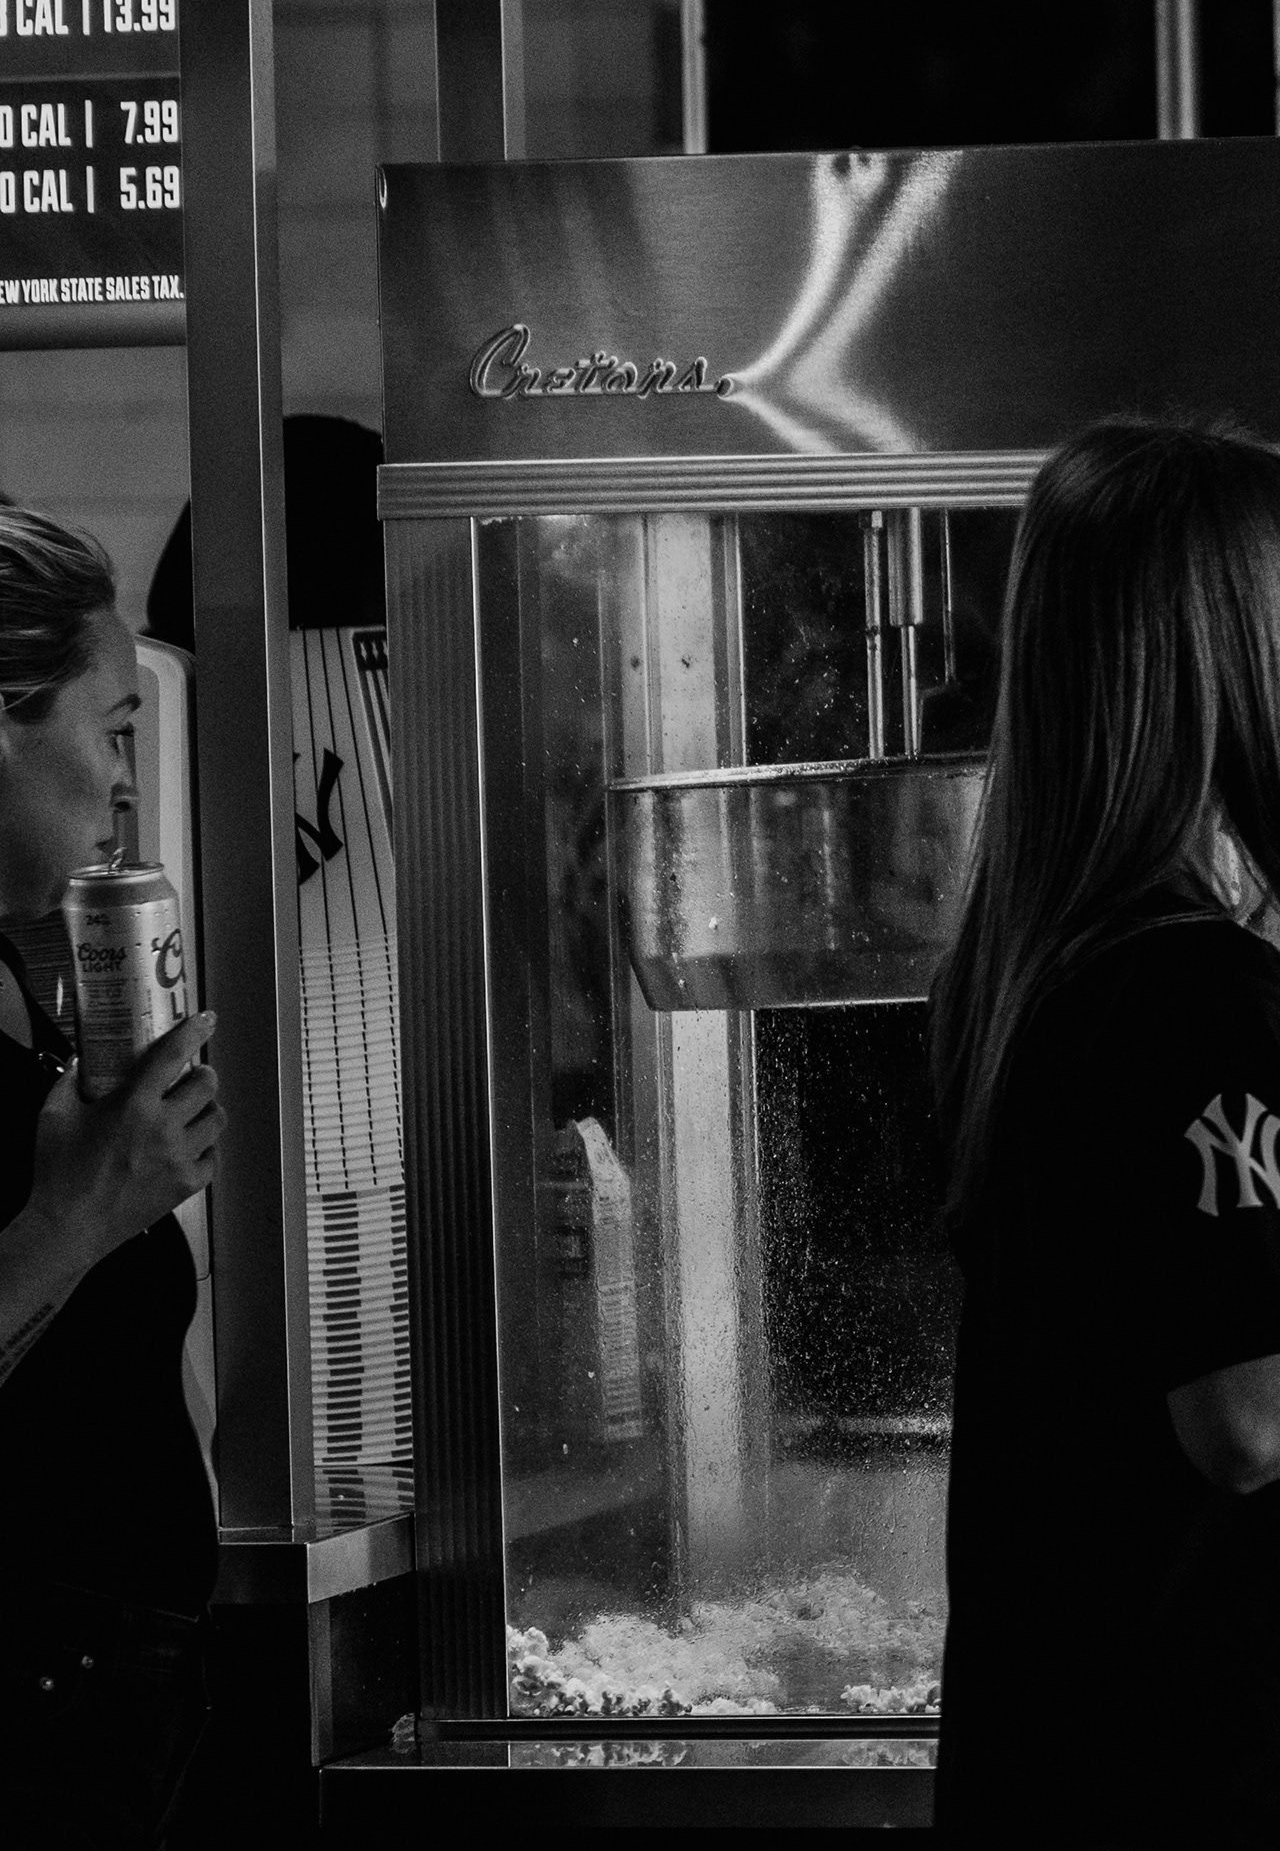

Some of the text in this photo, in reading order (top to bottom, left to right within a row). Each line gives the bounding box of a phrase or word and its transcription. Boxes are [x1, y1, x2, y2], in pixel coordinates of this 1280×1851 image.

[21, 103, 72, 148] CAL
[120, 99, 179, 145] 7.99
[23, 168, 74, 213] CAL
[119, 165, 181, 210] 5.69
[21, 279, 58, 303] YORK
[60, 278, 103, 302] STATE
[105, 277, 150, 301] SALES
